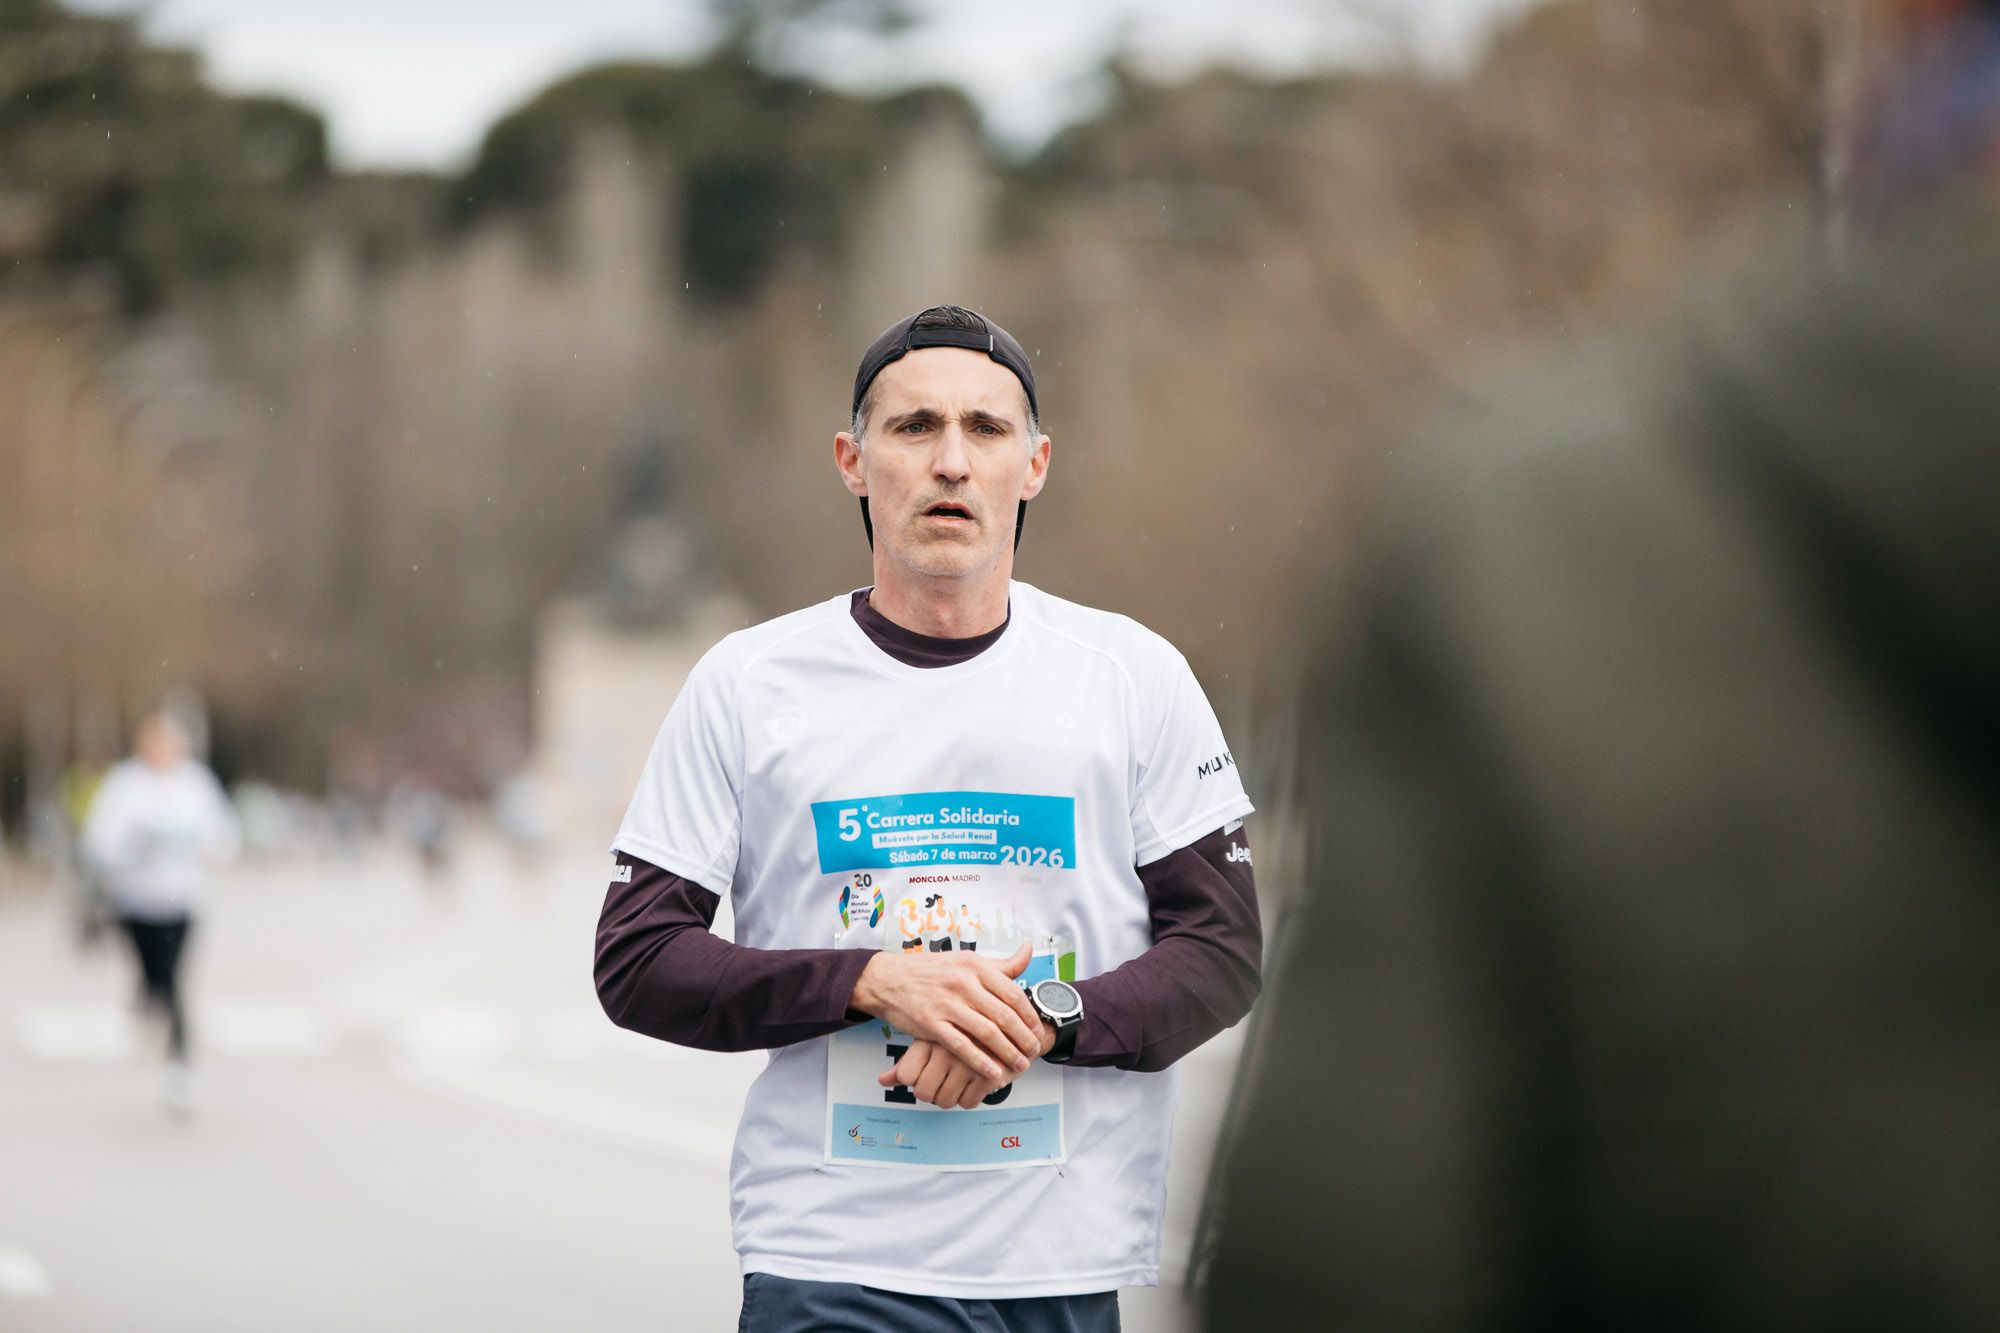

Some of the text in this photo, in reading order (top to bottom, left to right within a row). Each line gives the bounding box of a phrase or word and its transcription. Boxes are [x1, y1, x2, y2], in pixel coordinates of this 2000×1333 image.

[866, 811, 935, 829] Carrera
[939, 807, 1020, 826] Solidaria
[879, 831, 993, 844] Muévete por la Salud Renal
[889, 845, 1065, 868] Sábado 7 de marzo 2026
[854, 873, 873, 887] 20
[909, 874, 981, 884] MONCLOA MADRID
[1001, 1136, 1021, 1148] CSL
